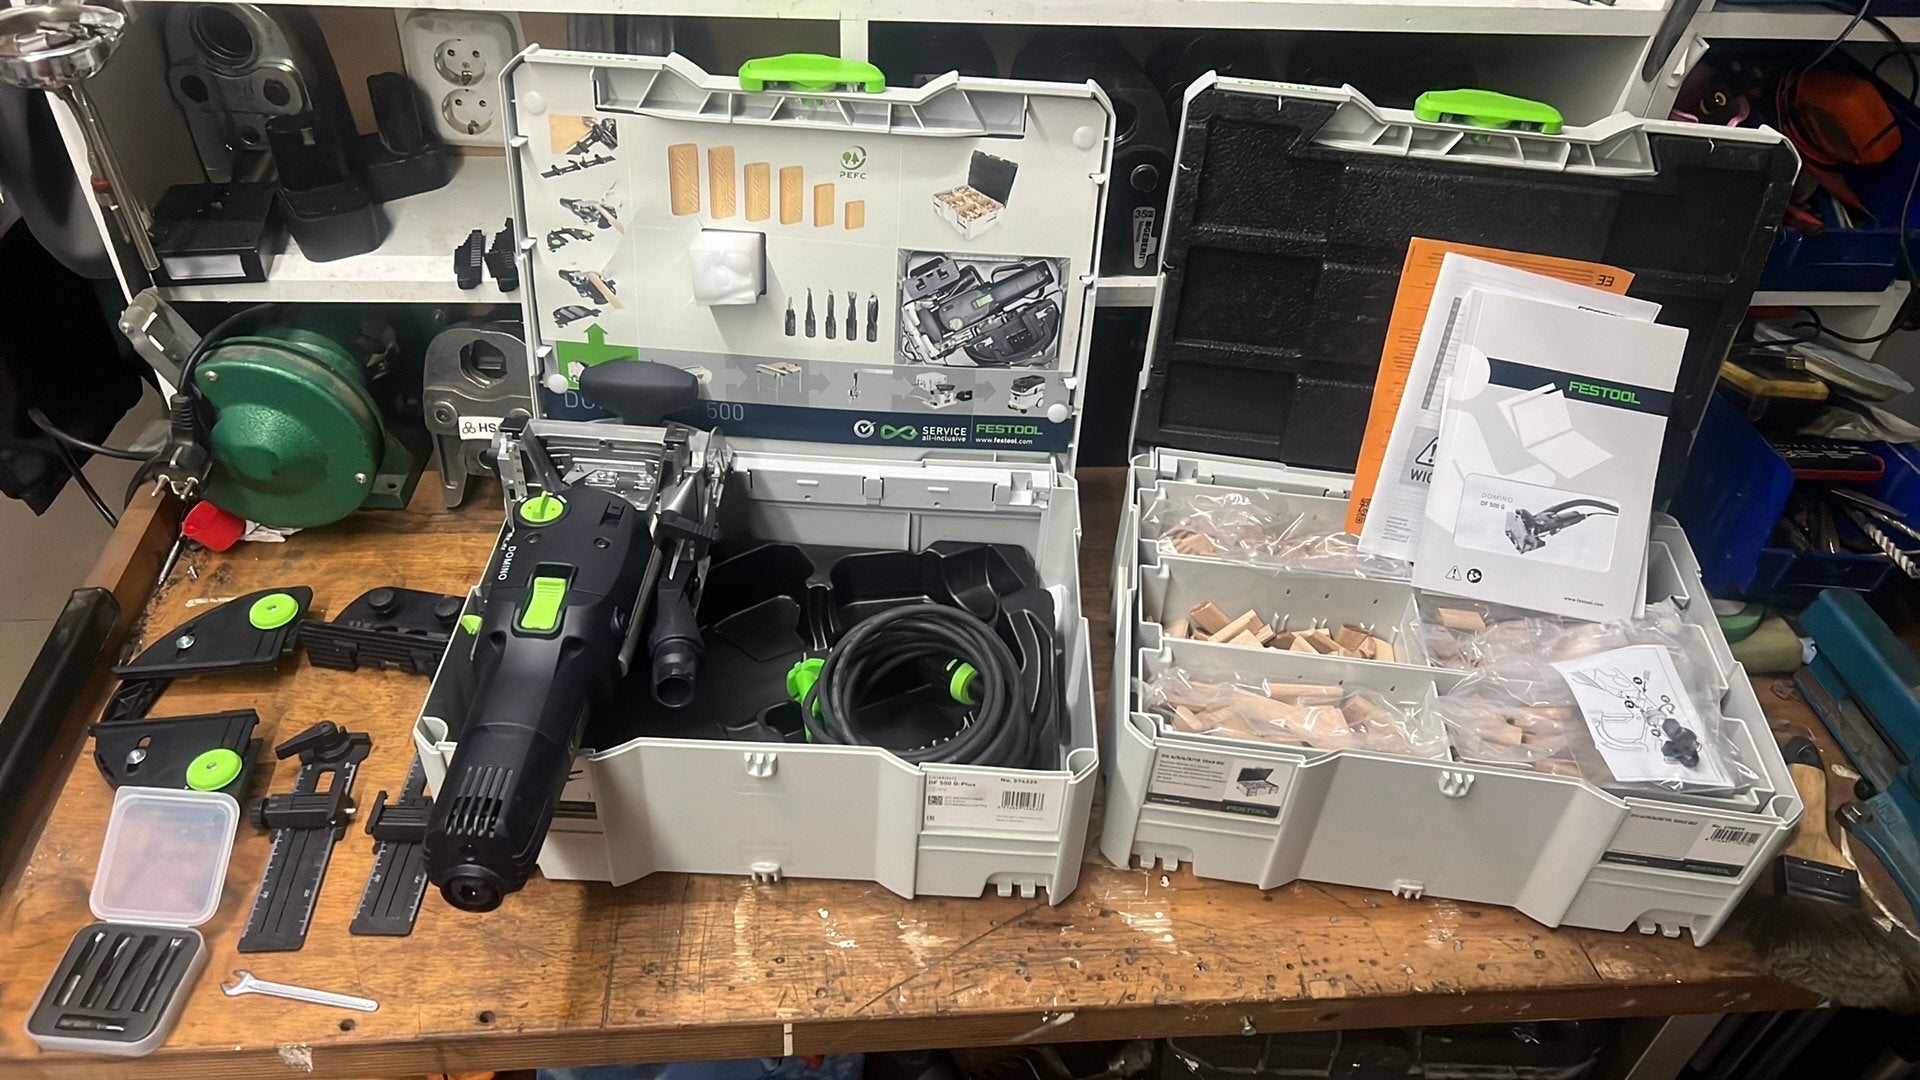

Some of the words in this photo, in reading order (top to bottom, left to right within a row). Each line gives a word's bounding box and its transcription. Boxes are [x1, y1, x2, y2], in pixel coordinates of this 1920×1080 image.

[840, 171, 866, 180] PEFC
[1568, 381, 1641, 405] FESTOOL
[706, 402, 744, 421] 500
[922, 426, 967, 436] SERVICE
[975, 423, 1043, 435] FESTOOL
[922, 435, 966, 443] all-inclusive
[975, 437, 1033, 445] www.festool.com
[498, 545, 517, 580] DOMINO
